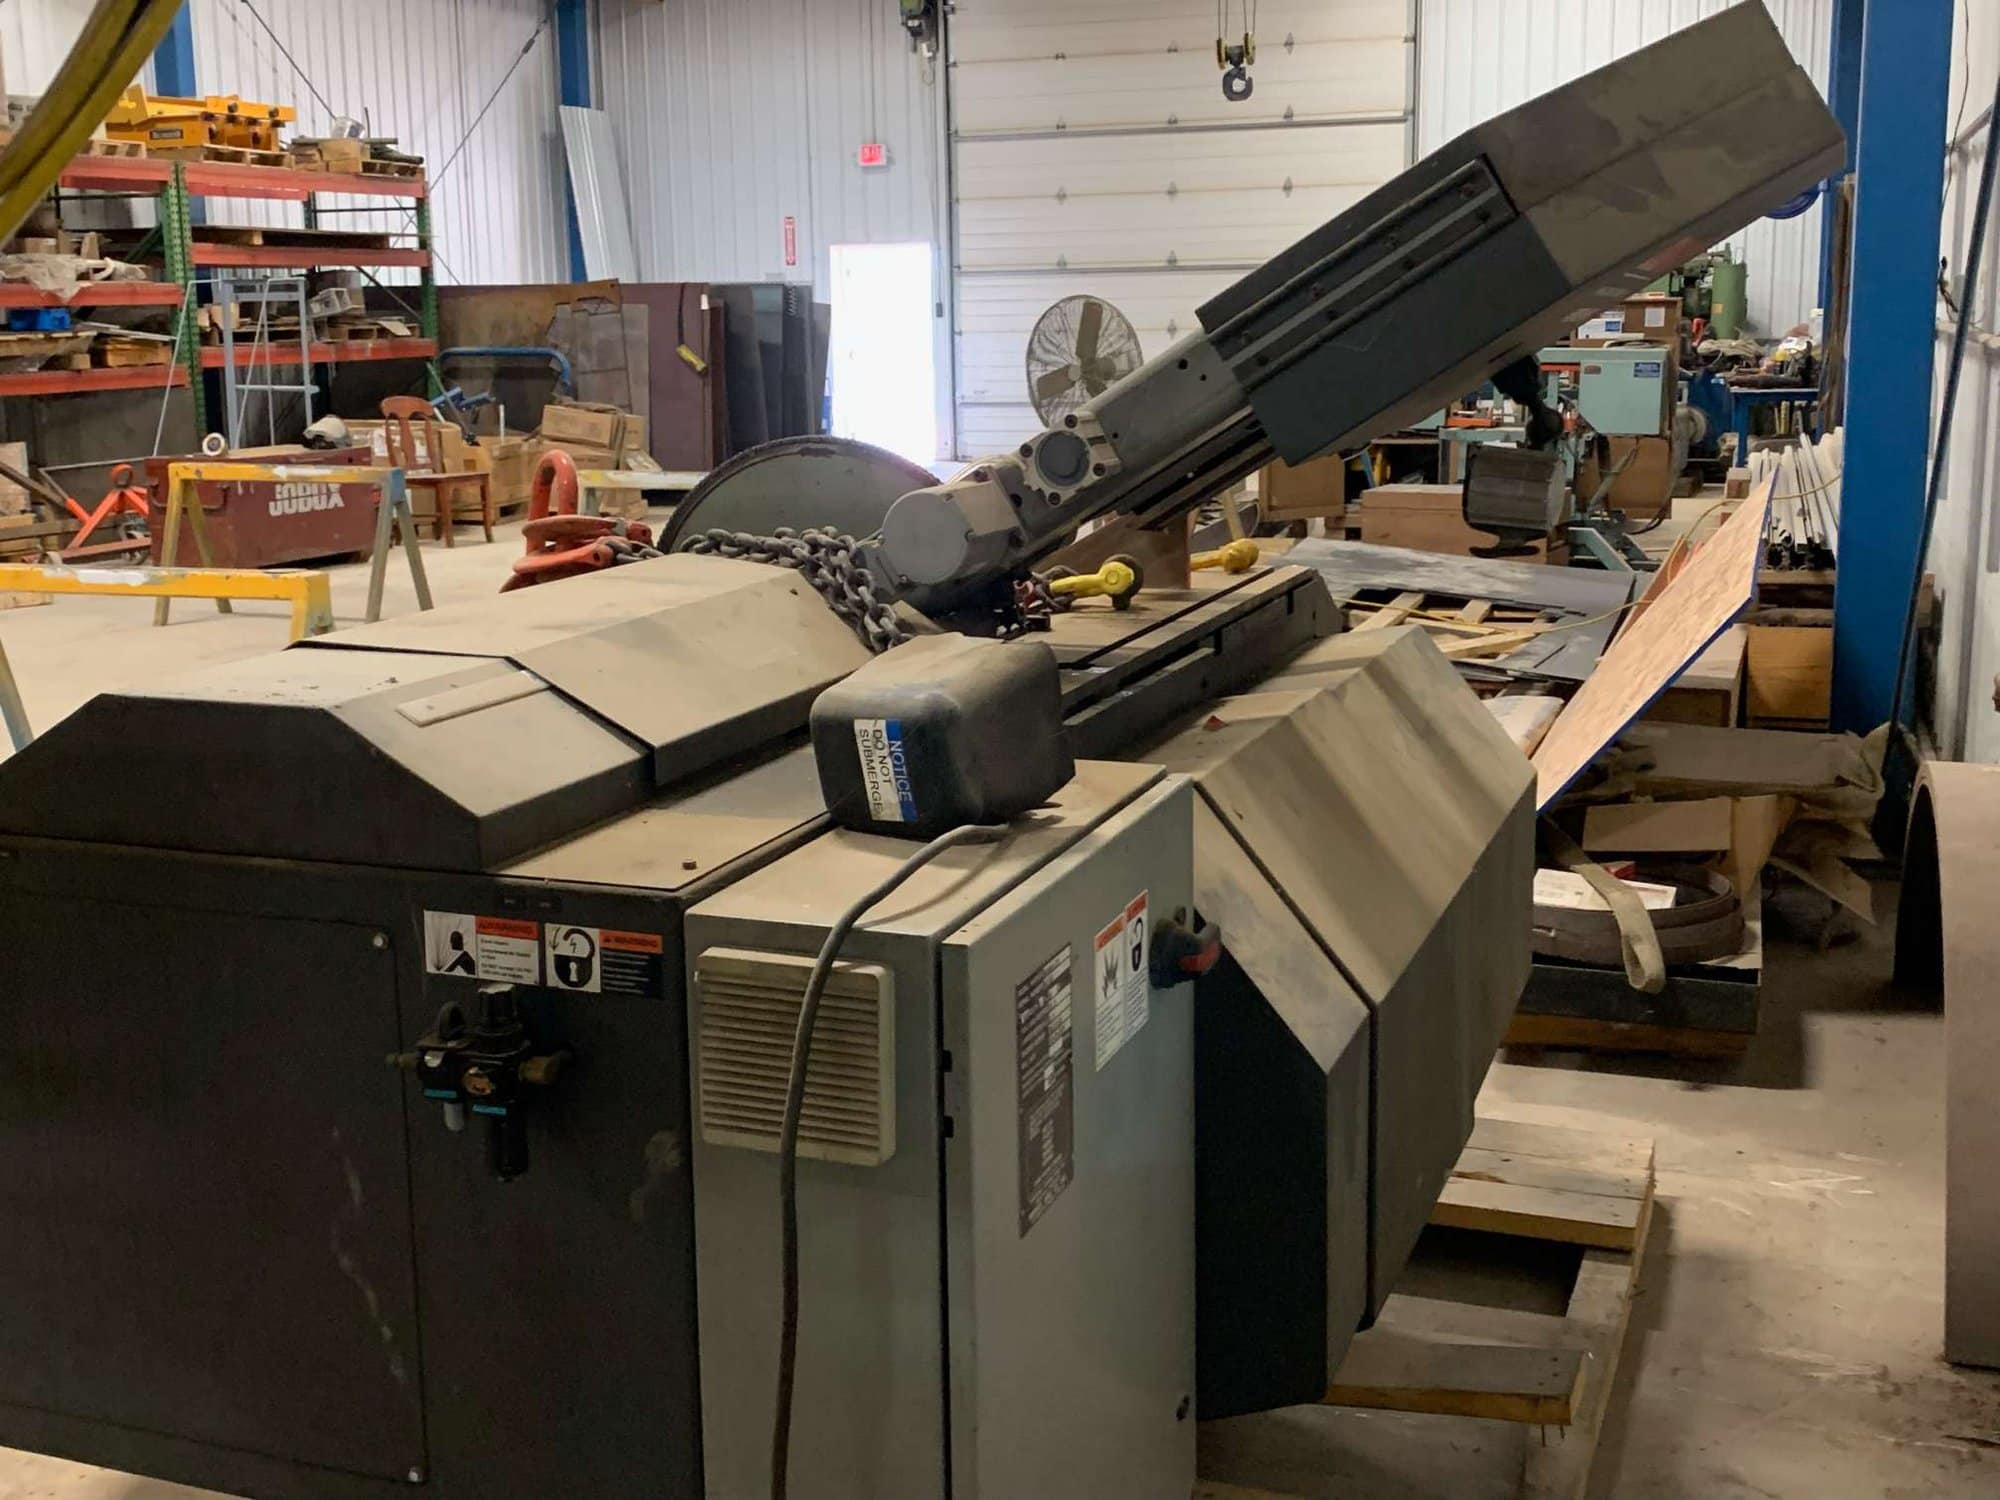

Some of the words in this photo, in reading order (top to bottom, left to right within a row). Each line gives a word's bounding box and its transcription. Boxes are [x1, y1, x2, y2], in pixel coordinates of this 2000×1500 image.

[268, 483, 345, 516] JOBOX
[872, 729, 885, 751] DO
[859, 728, 883, 812] SUBMERGE
[878, 755, 894, 786] NOT
[888, 740, 913, 802] NOTICE
